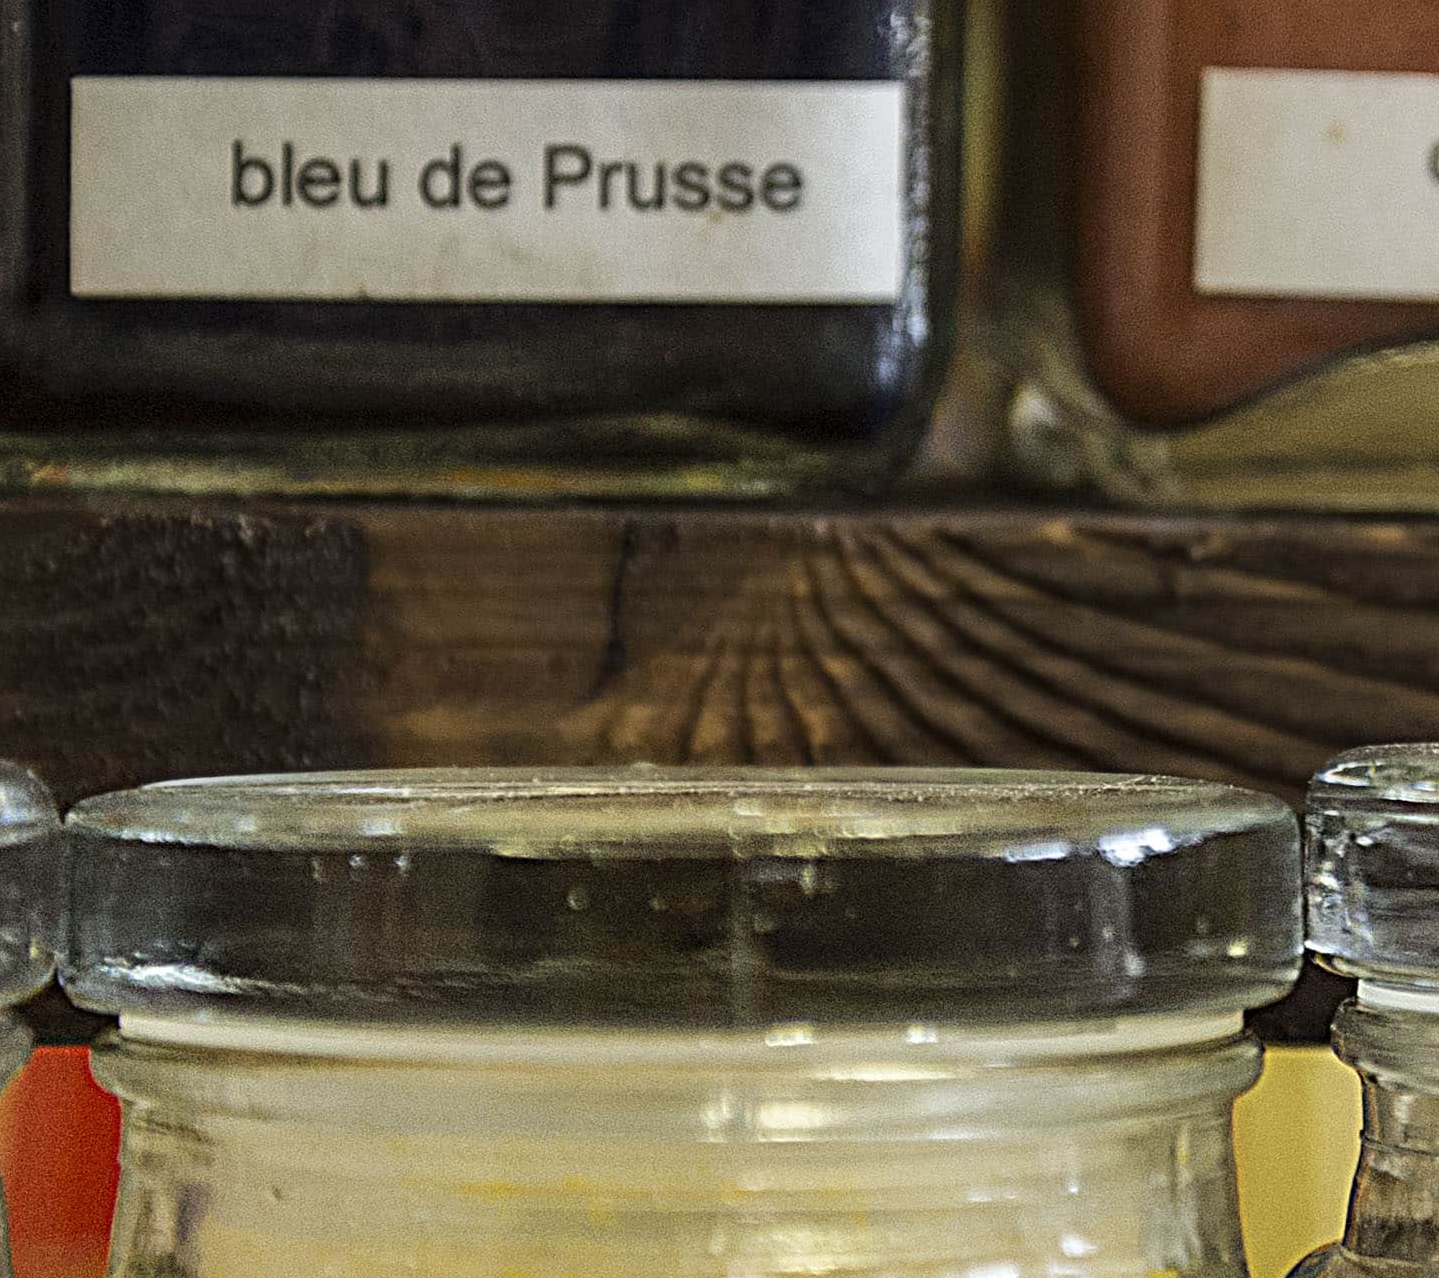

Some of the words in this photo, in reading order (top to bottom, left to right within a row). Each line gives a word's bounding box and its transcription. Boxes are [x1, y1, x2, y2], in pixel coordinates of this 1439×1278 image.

[230, 139, 390, 209] bleu
[417, 141, 512, 210] de
[543, 143, 805, 214] Prusse
